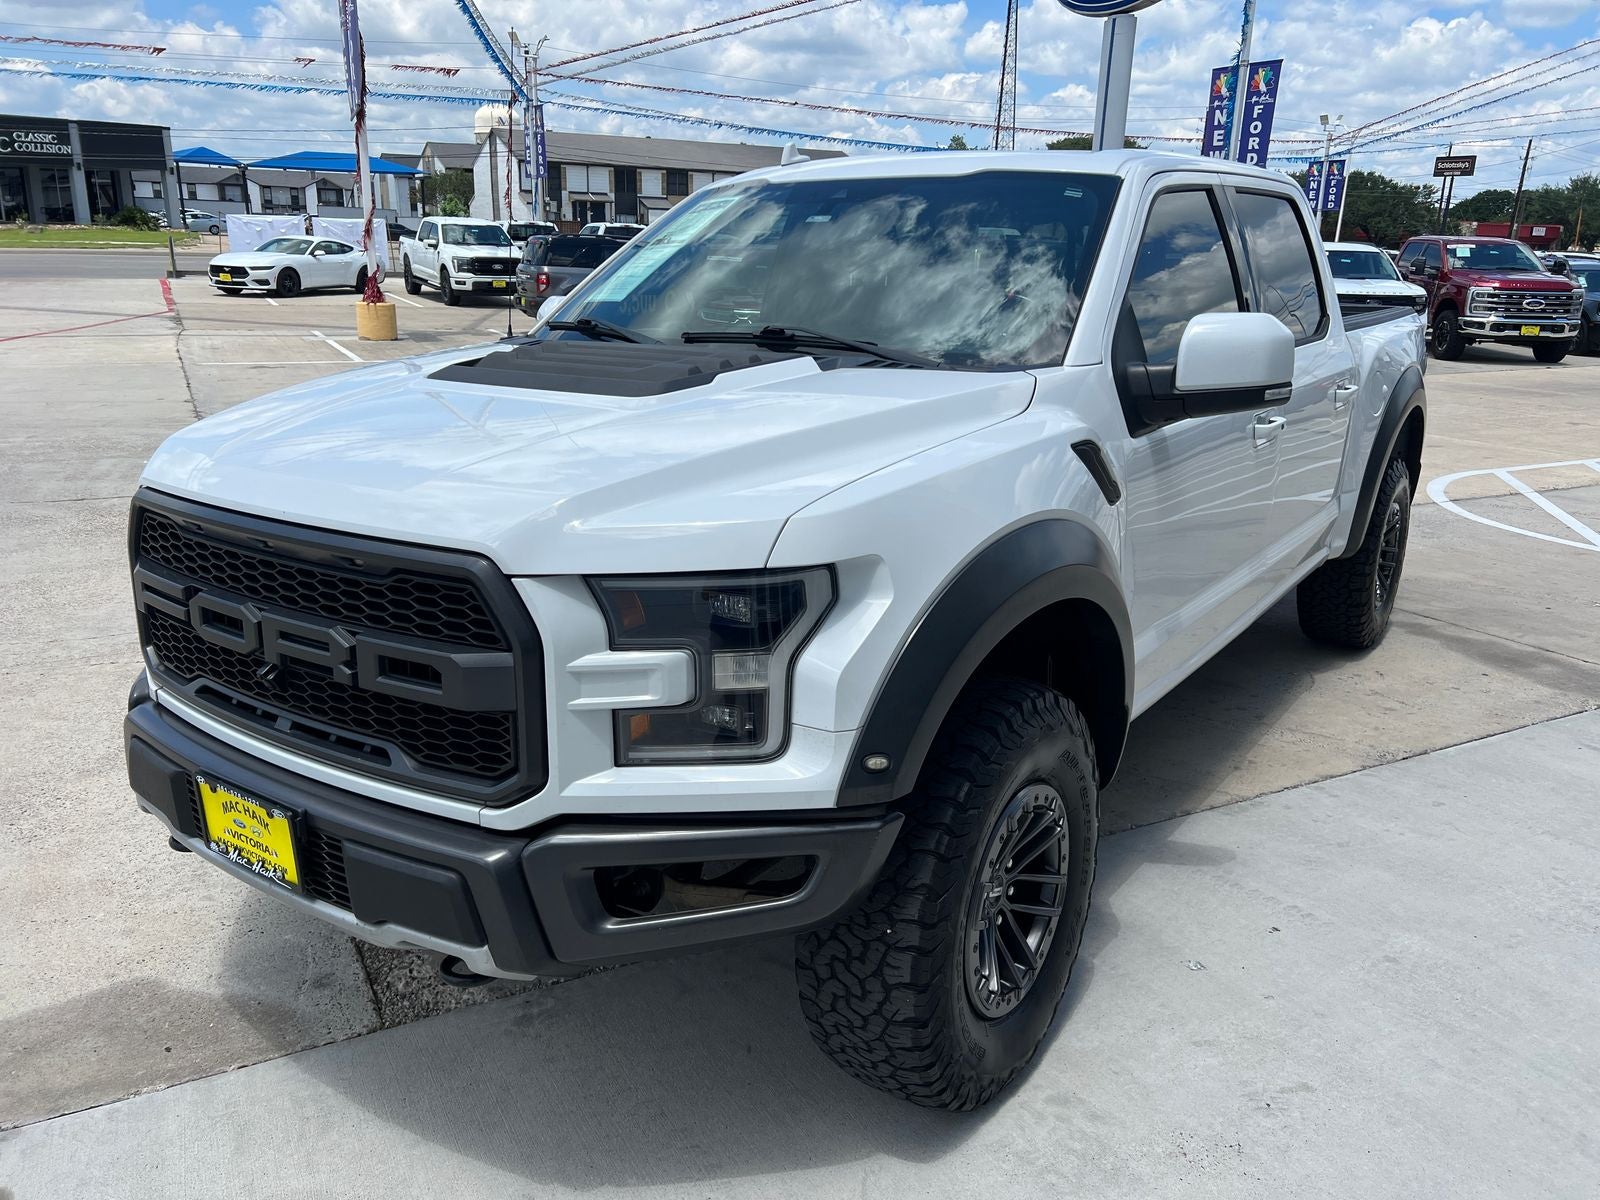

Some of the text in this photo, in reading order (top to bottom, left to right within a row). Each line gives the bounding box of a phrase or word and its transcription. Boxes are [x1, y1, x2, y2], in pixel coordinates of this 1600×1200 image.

[13, 131, 58, 143] CLASSIC
[14, 142, 72, 154] COLLISION
[1246, 105, 1263, 166] FORD
[1327, 179, 1337, 209] FORD
[134, 566, 515, 712] FORD
[222, 800, 242, 814] MAC
[242, 803, 272, 836] HAIK
[230, 830, 272, 856] VICTORIA
[228, 848, 278, 880] Mac Haik
